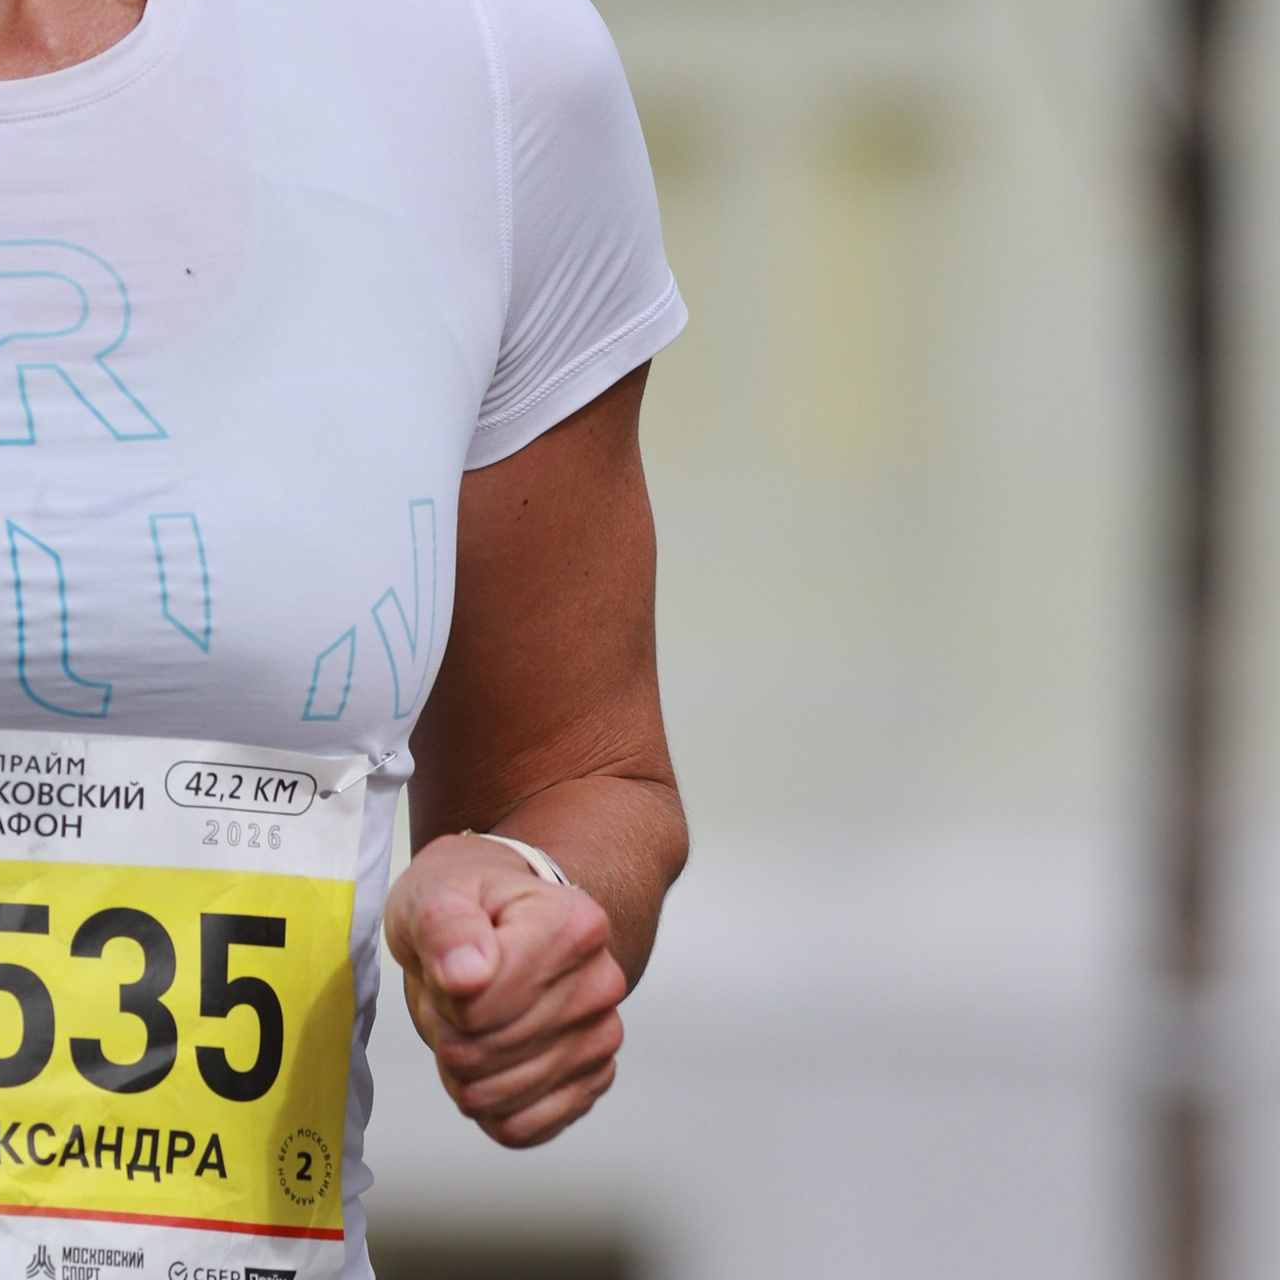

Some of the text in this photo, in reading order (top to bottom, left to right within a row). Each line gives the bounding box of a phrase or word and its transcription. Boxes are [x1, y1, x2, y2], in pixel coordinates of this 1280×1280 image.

[185, 771, 244, 802] 42,2
[202, 819, 282, 849] 2026
[296, 1151, 312, 1182] 2
[61, 1246, 145, 1269] МОСКОВСКИЙ
